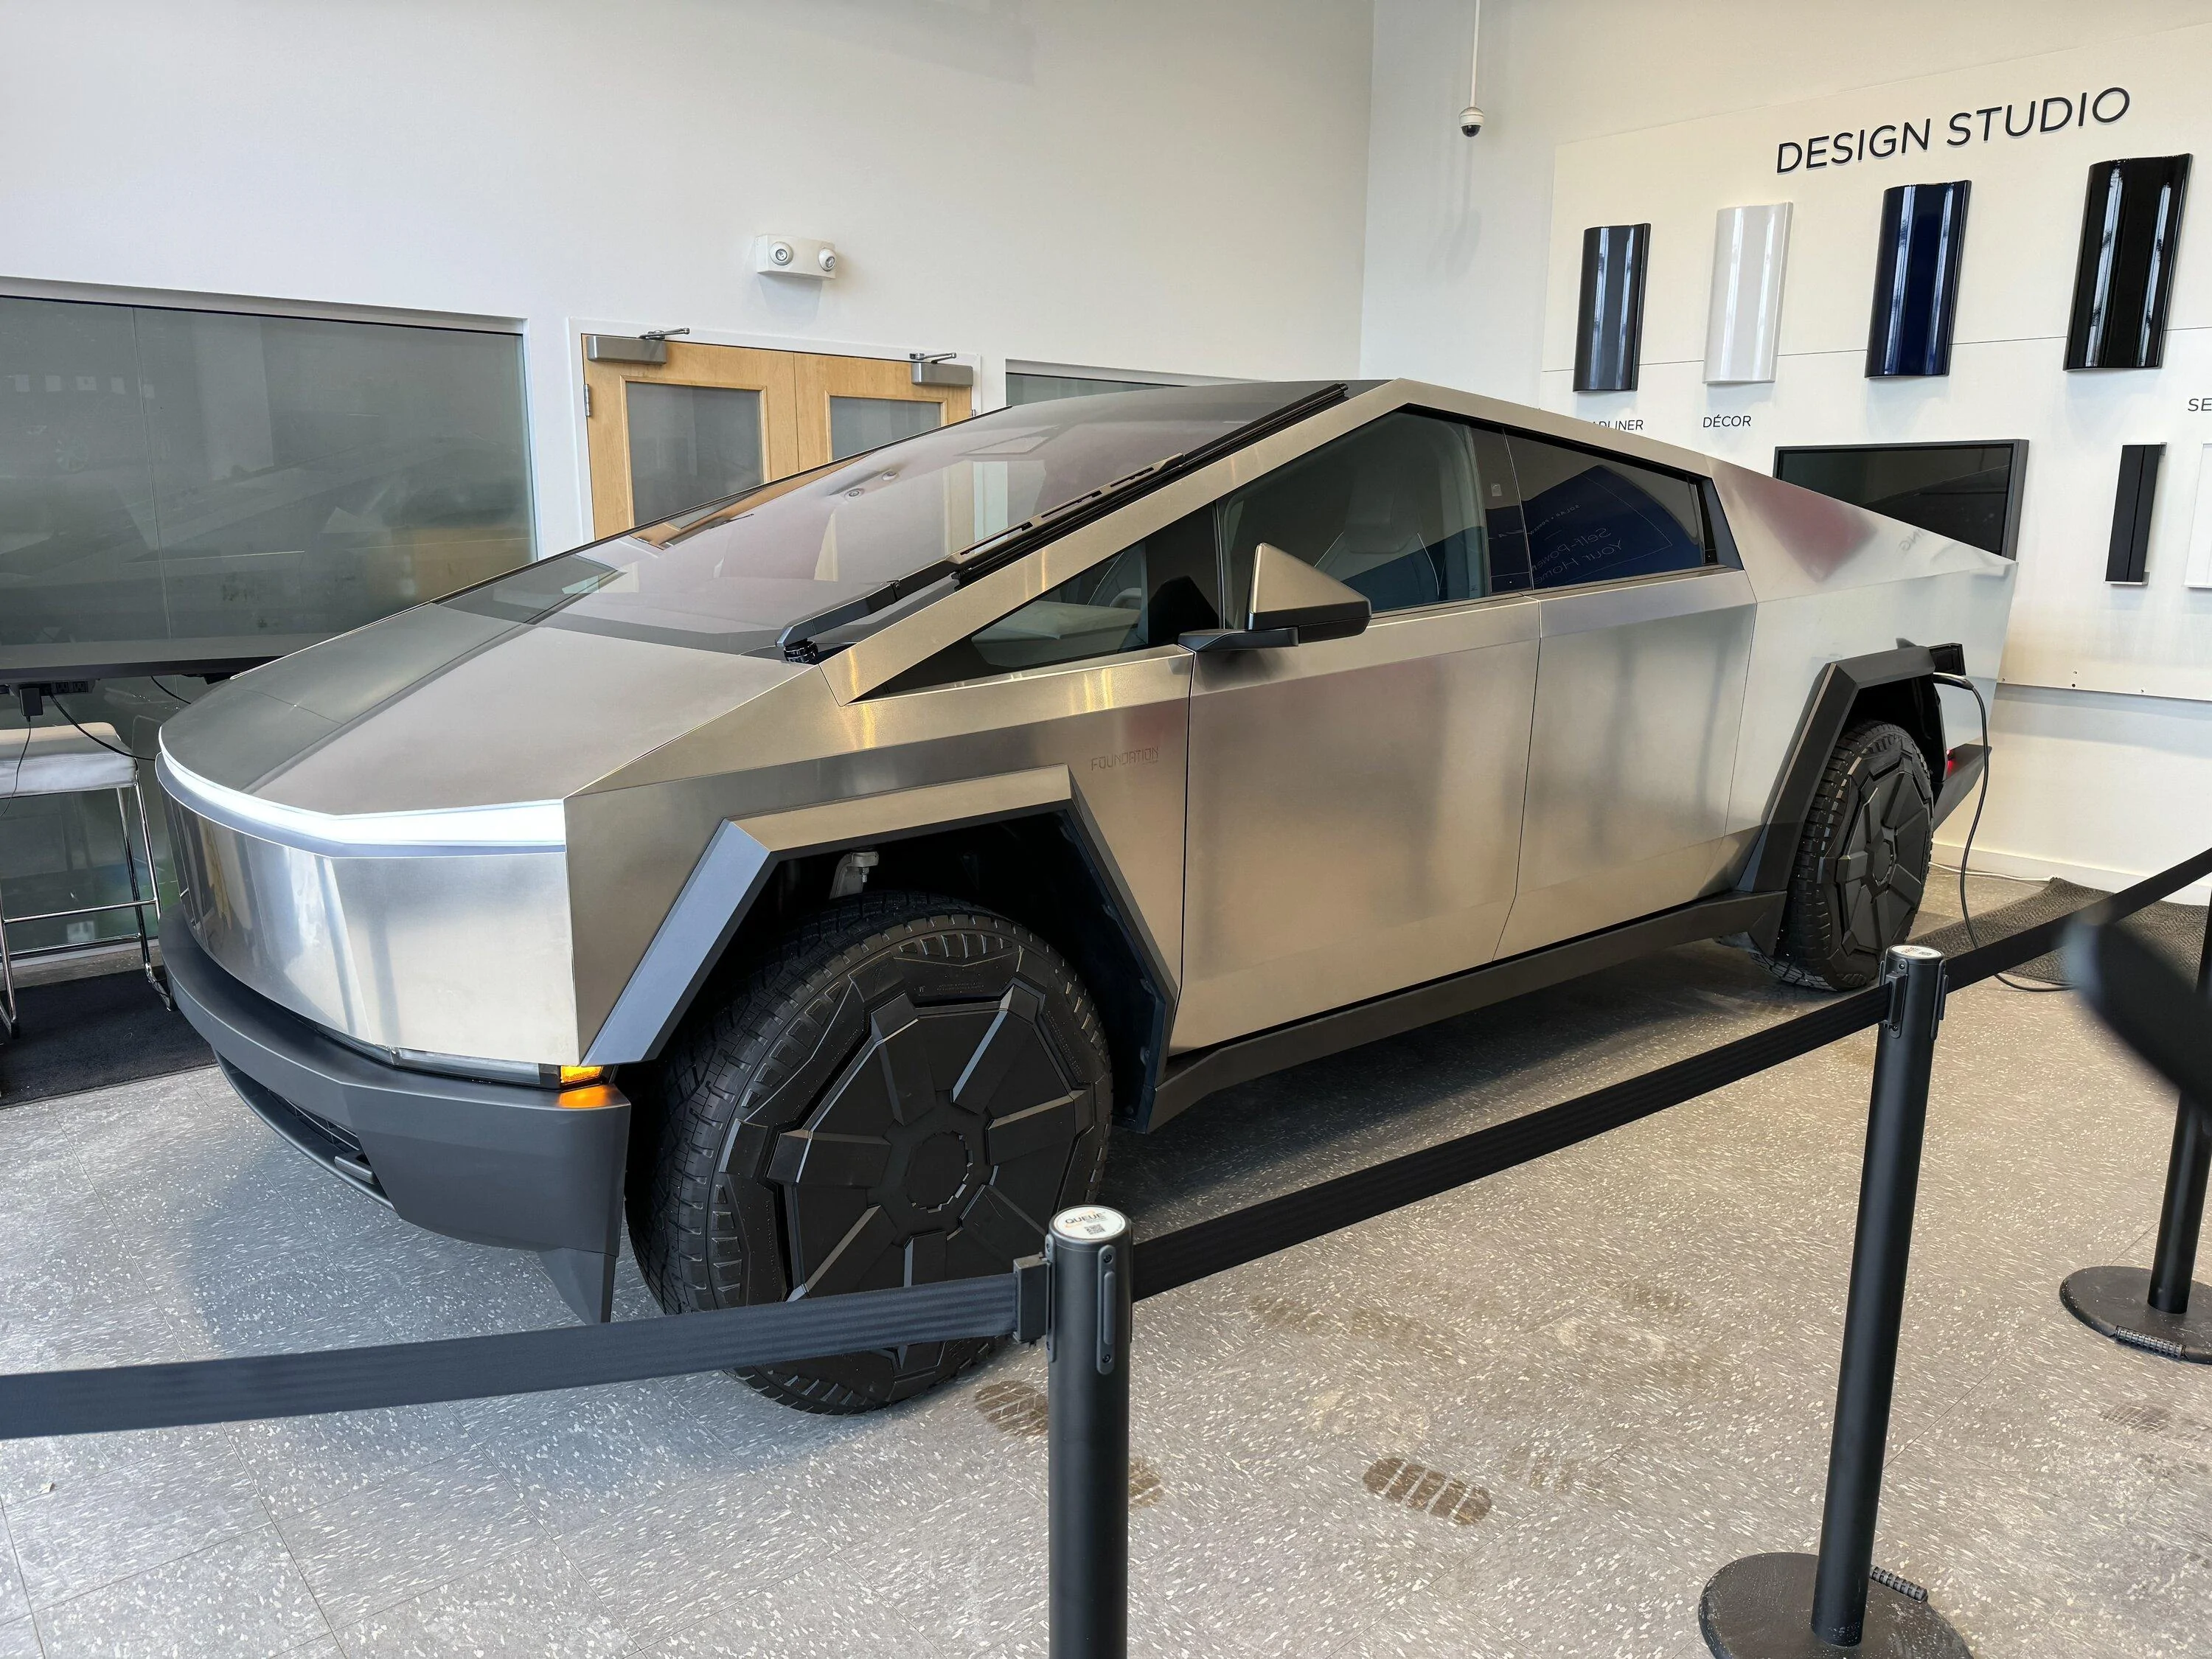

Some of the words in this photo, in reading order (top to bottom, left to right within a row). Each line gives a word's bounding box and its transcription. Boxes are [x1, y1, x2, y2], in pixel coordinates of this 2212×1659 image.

[1776, 118, 1931, 174] DESIGN
[1946, 86, 2131, 147] STUDIO
[2188, 397, 2212, 412] SE
[1593, 419, 1644, 431] DLINER
[1703, 414, 1752, 428] DÉCOR
[1091, 745, 1159, 771] FOUNDATION
[1065, 1212, 1105, 1224] QUEUE
